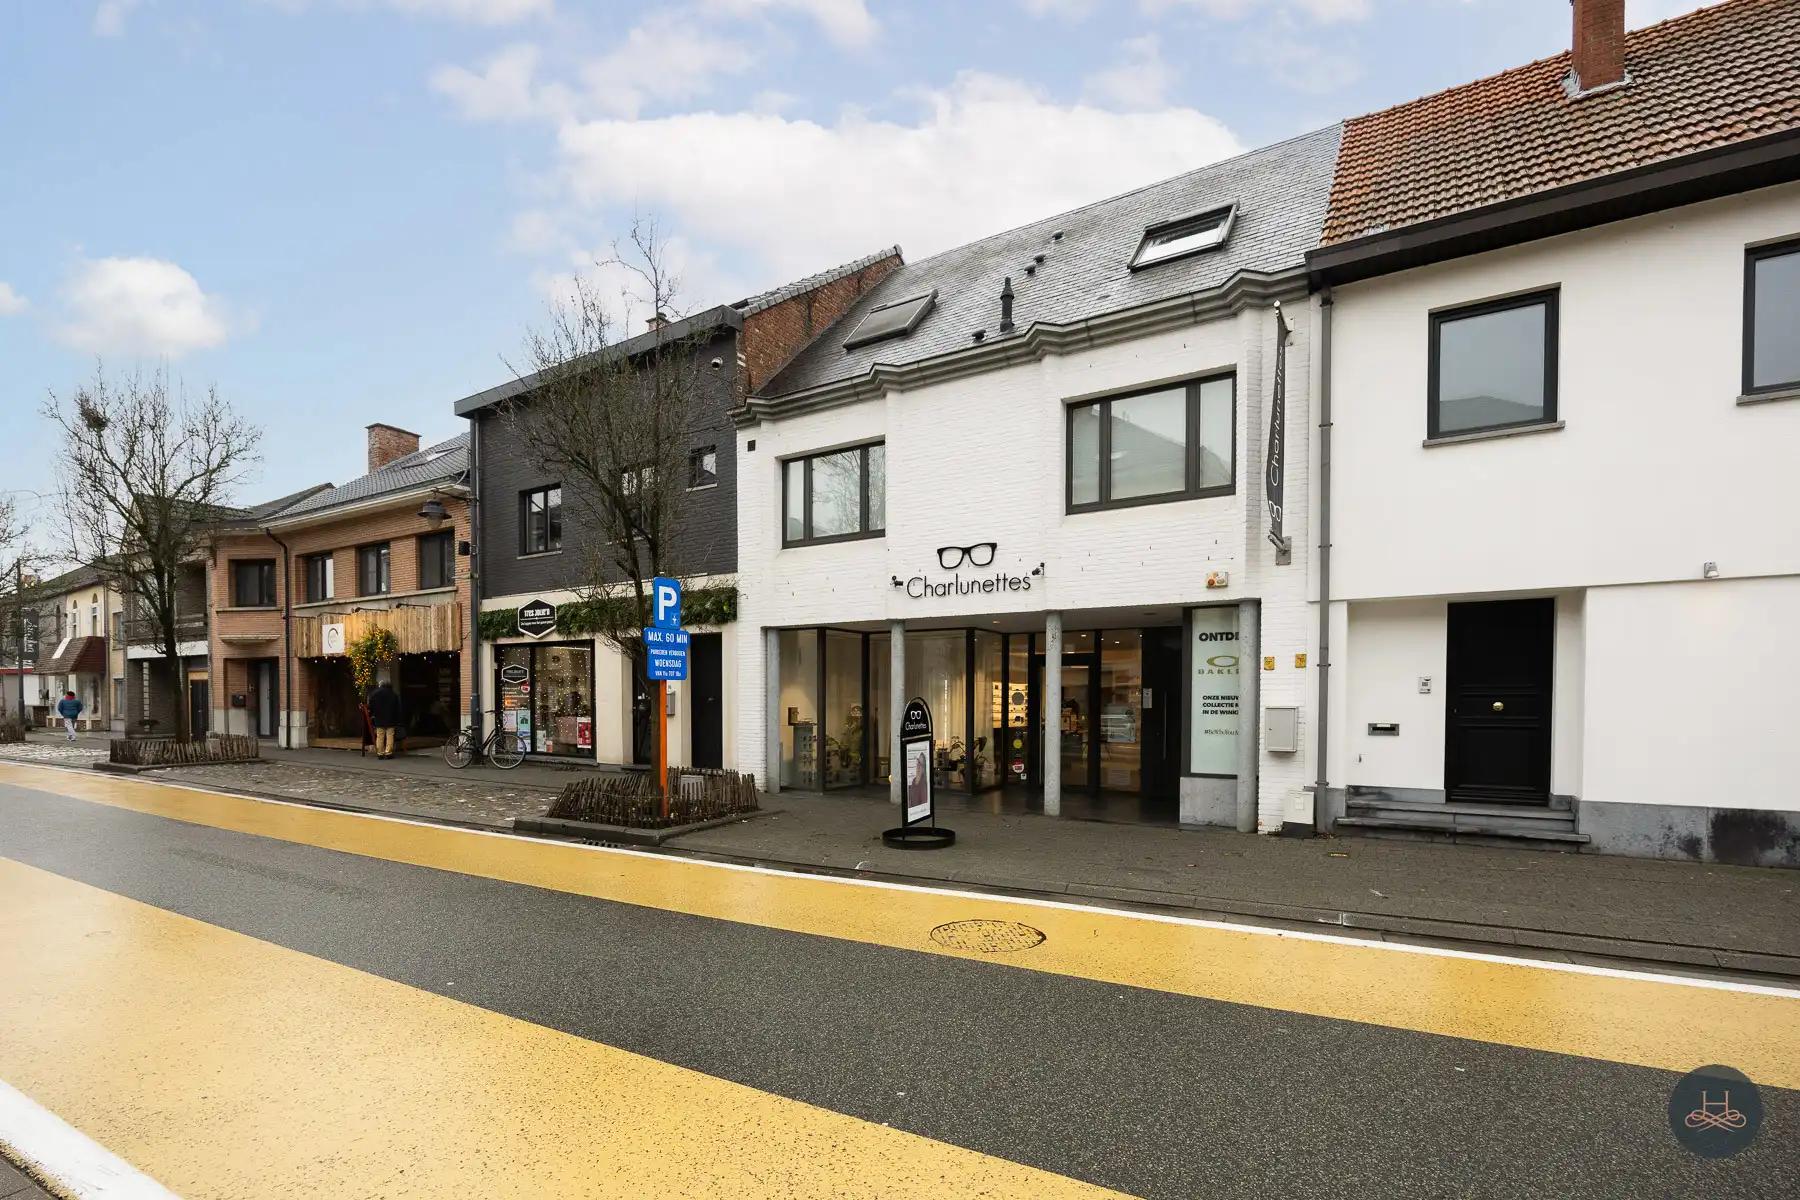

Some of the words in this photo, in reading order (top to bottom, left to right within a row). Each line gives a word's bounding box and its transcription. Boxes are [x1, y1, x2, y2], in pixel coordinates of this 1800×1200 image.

[1271, 345, 1283, 487] Charlunettes
[907, 573, 1031, 598] Charlunettes
[658, 586, 678, 621] P
[648, 631, 664, 642] MAX.
[665, 632, 675, 643] 60
[676, 634, 688, 644] MIN
[654, 659, 682, 668] WOENSDAG
